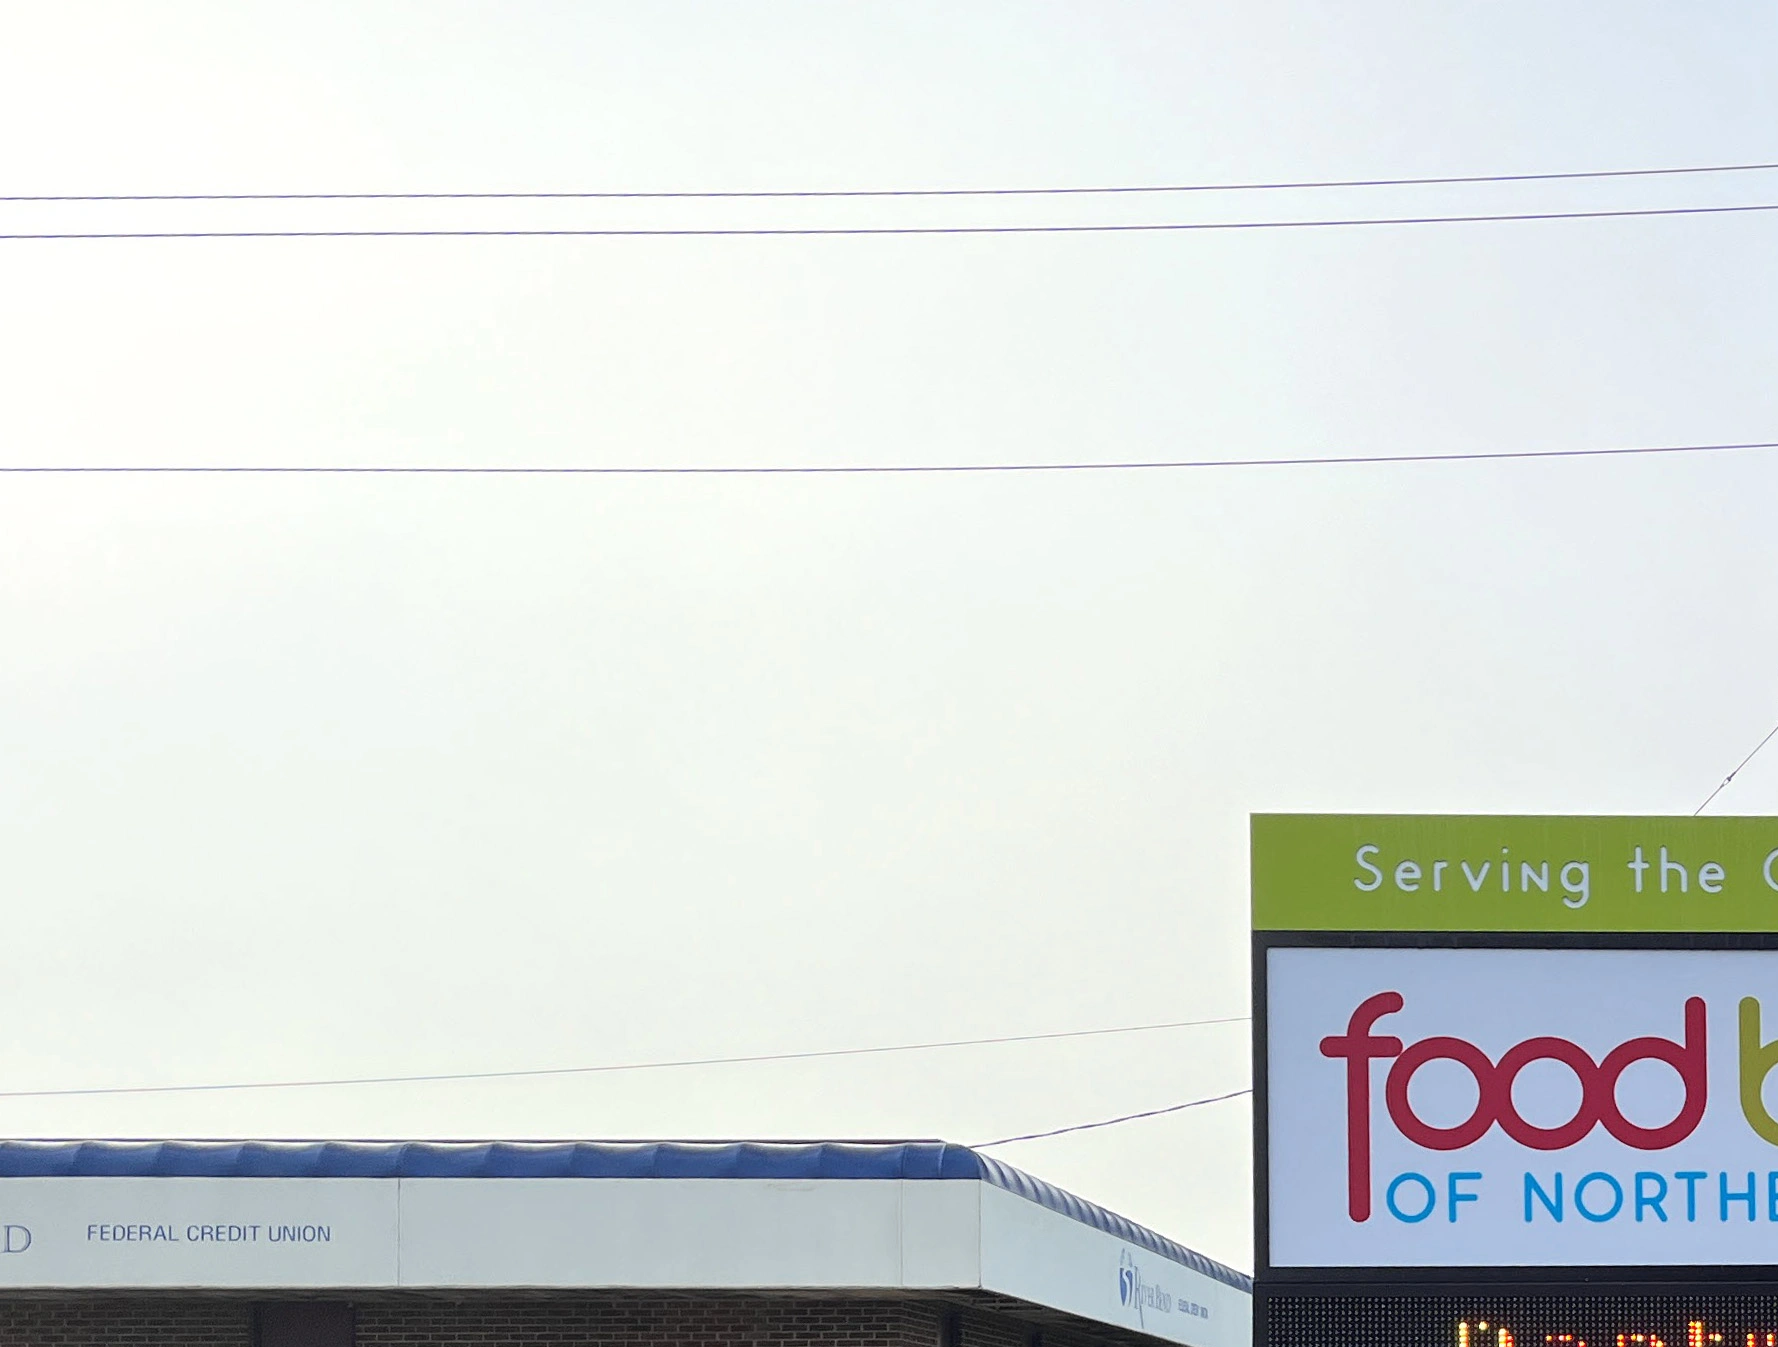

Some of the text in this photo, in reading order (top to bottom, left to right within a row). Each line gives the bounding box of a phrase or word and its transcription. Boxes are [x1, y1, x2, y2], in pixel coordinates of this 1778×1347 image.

[1628, 847, 1725, 893] the
[1320, 992, 1707, 1222] food
[1387, 1171, 1482, 1223] OF
[87, 1224, 331, 1243] FEDERAL CREDIT UNION
